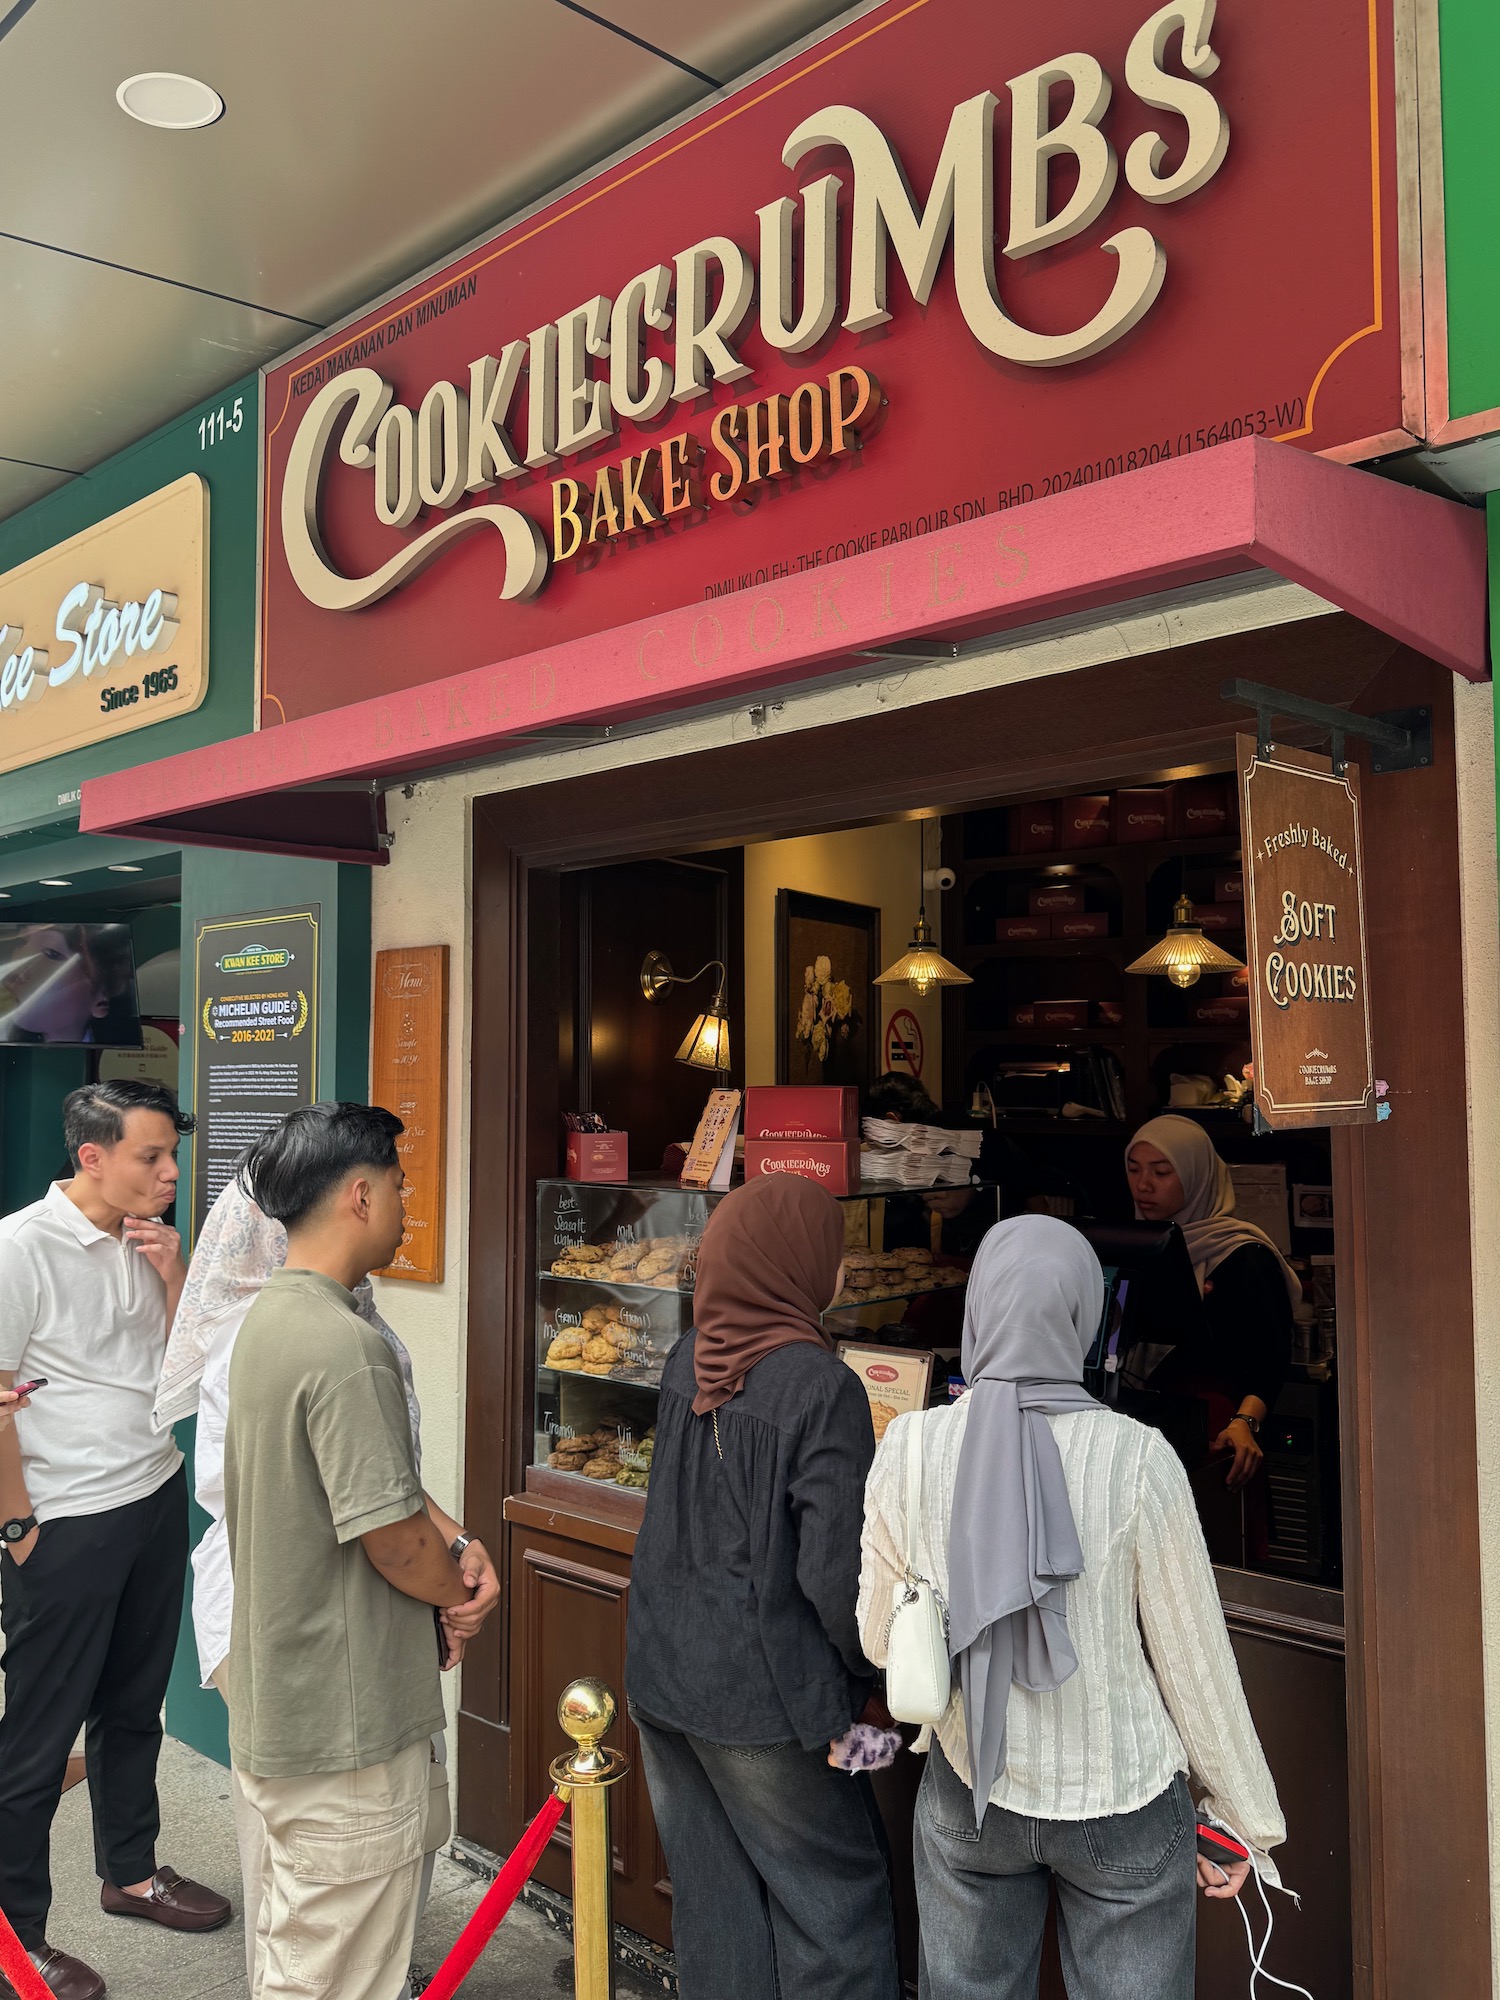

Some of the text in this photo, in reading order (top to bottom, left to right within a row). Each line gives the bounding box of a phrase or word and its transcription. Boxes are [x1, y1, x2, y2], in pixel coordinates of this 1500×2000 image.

[292, 275, 477, 399] KEDAI MAKANAN DAN MINUMAN
[198, 397, 244, 450] 111-5
[551, 365, 876, 563] BAKE SHOP
[797, 551, 822, 573] THE
[826, 532, 877, 564] COOKIE
[882, 510, 949, 547] PARLOUR
[1042, 440, 1172, 498] 202401018204
[1177, 397, 1305, 456] (1564053-W)
[637, 525, 1030, 681] COOKIES
[49, 581, 174, 688] Store
[100, 664, 178, 712] Since 1965
[1263, 822, 1348, 870] Freshly Baked
[224, 952, 285, 969] KWAN KEE STORE
[390, 971, 423, 990] Menu
[1265, 951, 1357, 1006] COOKIES
[214, 1014, 295, 1029] Recommended Street Food
[218, 1000, 290, 1017] MICHELIN GUIDE
[231, 1028, 275, 1043] 2016-2021
[760, 1158, 831, 1178] COOKIECRUMBS
[884, 1387, 910, 1397] SPECIAL
